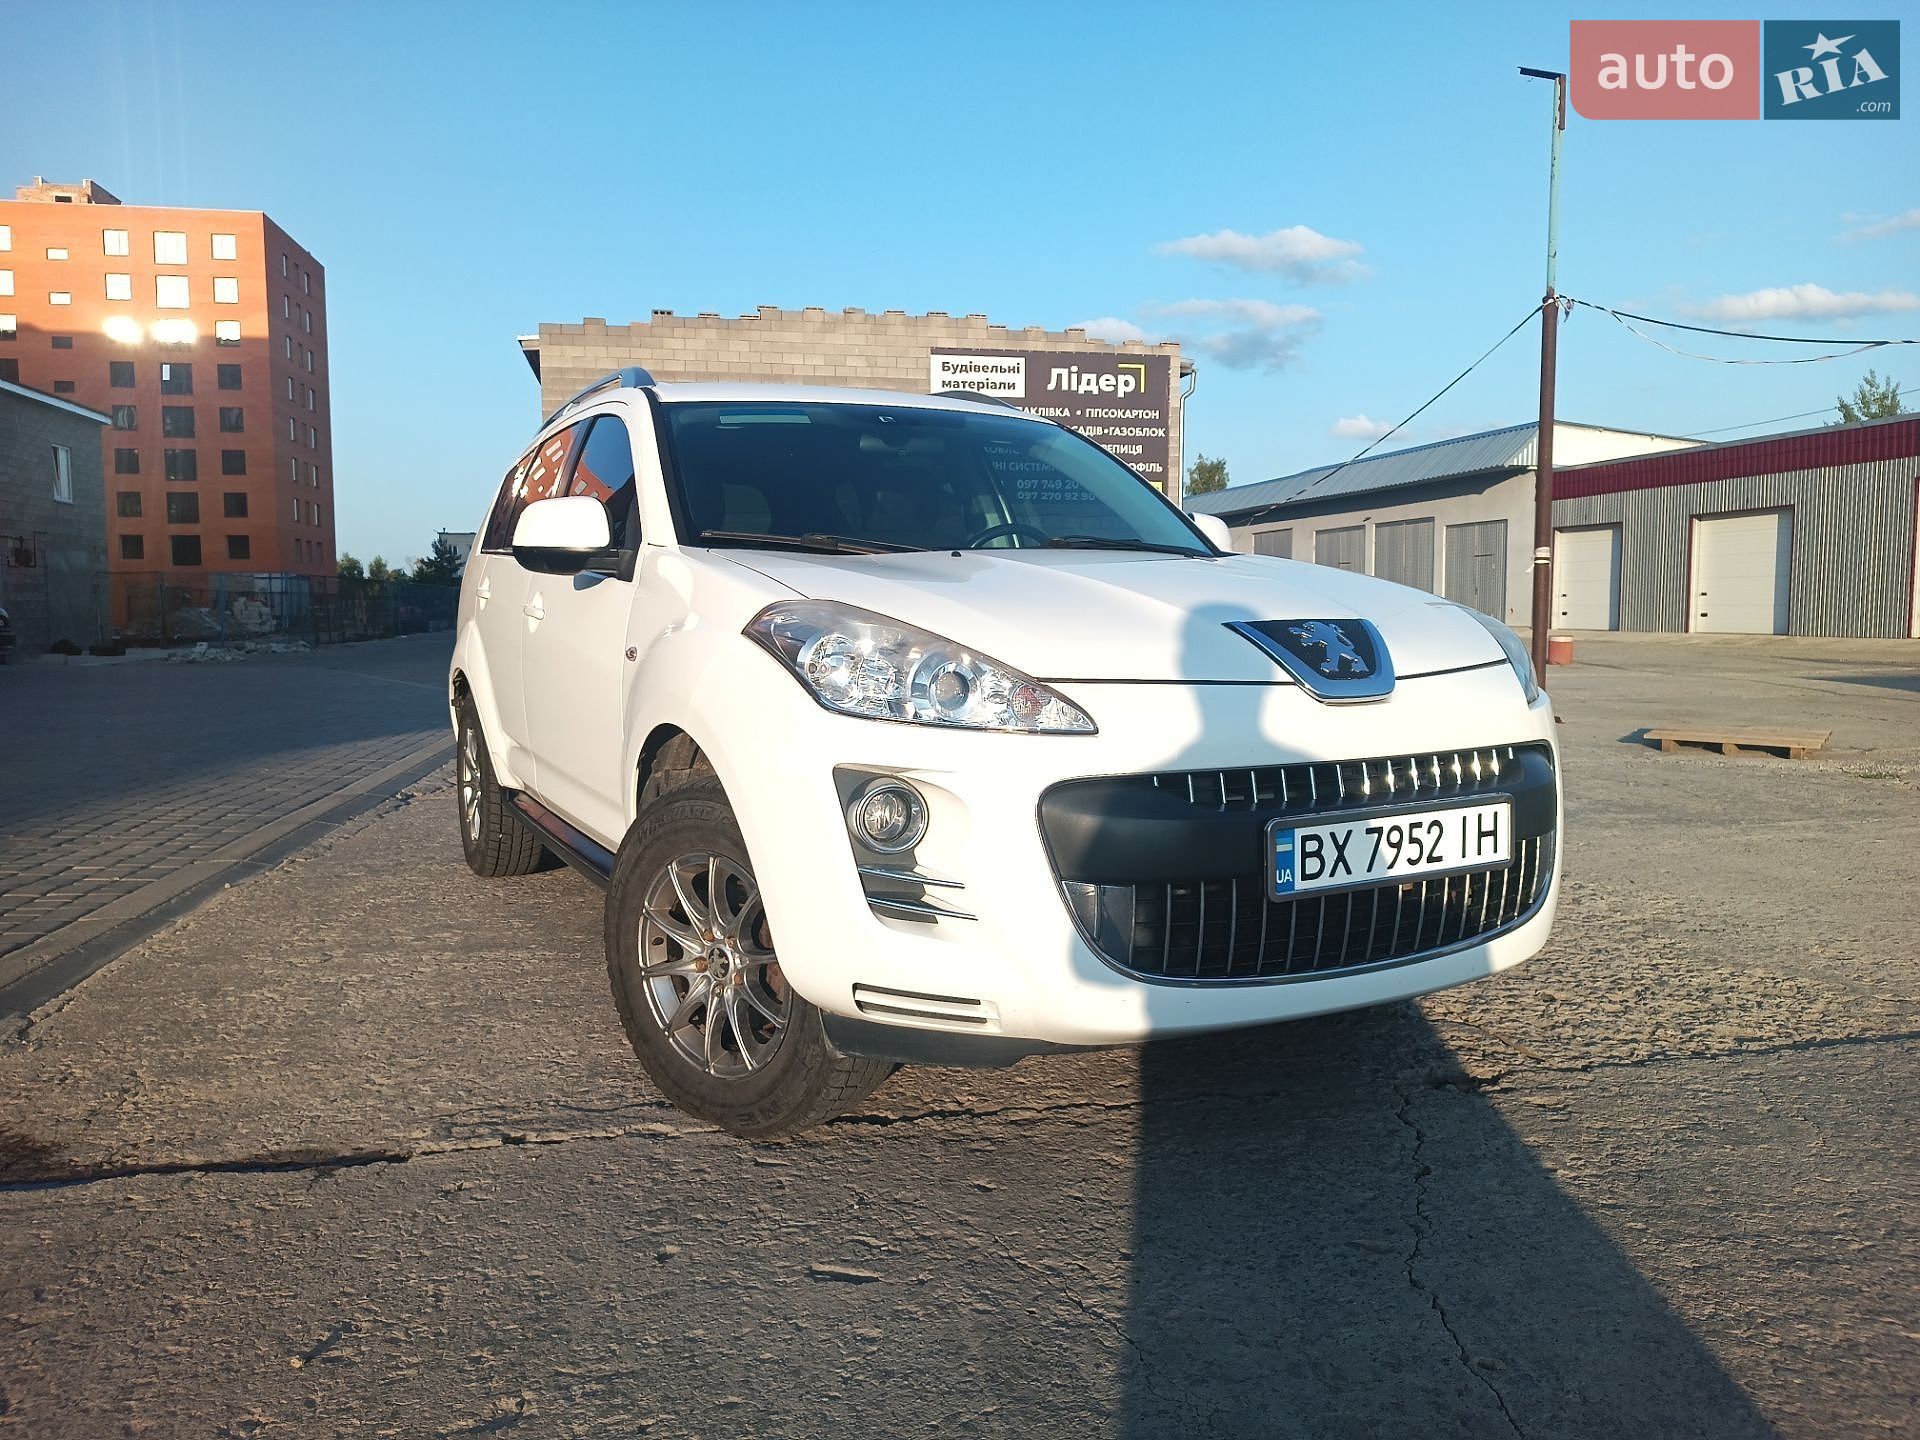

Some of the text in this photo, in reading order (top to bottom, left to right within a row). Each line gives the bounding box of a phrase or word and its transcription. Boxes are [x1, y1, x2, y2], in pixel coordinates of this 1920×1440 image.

[941, 361, 1021, 375] Будівельні
[941, 378, 1017, 392] матеріали
[1047, 365, 1136, 398] Лідер
[1066, 425, 1166, 437] САДІВ ГАЗОБЛОК
[1301, 811, 1499, 882] BX 7952 IH
[1276, 868, 1294, 884] UA
